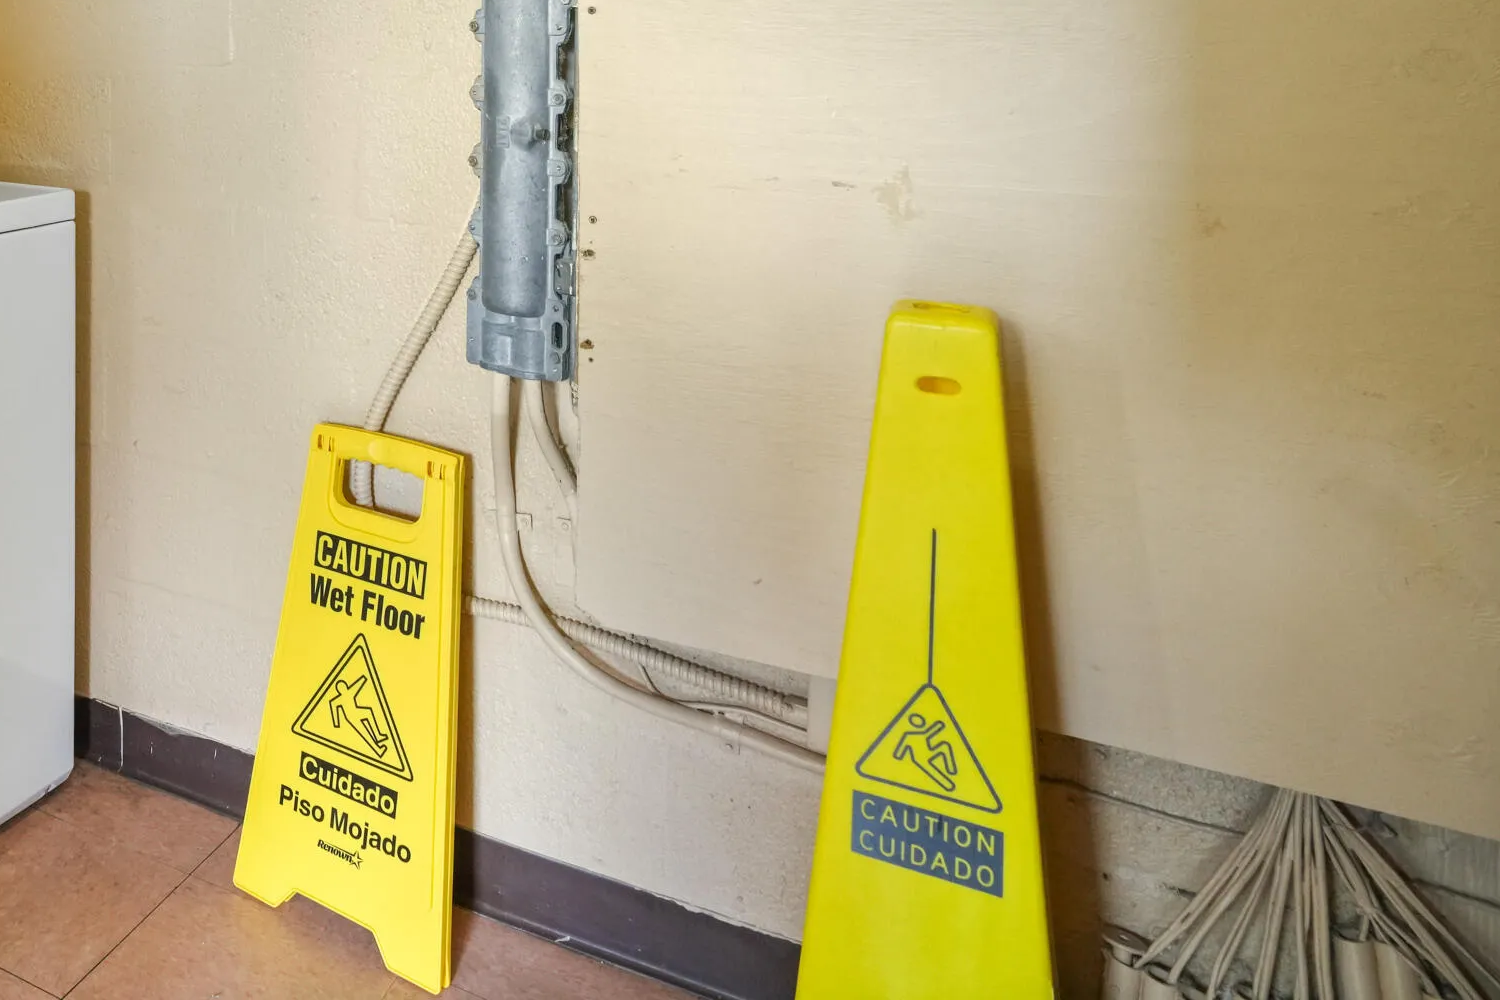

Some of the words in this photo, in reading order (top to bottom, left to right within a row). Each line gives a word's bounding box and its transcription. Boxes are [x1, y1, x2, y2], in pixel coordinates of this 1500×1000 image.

[316, 533, 426, 598] CAUTION
[309, 572, 355, 617] Wet
[360, 588, 426, 640] Floor
[301, 756, 396, 815] Cuidado
[278, 784, 325, 823] Piso
[329, 806, 412, 864] Mojado
[316, 839, 355, 863] Renown
[859, 798, 996, 858] CAUTION
[858, 829, 996, 889] CUIDADO
